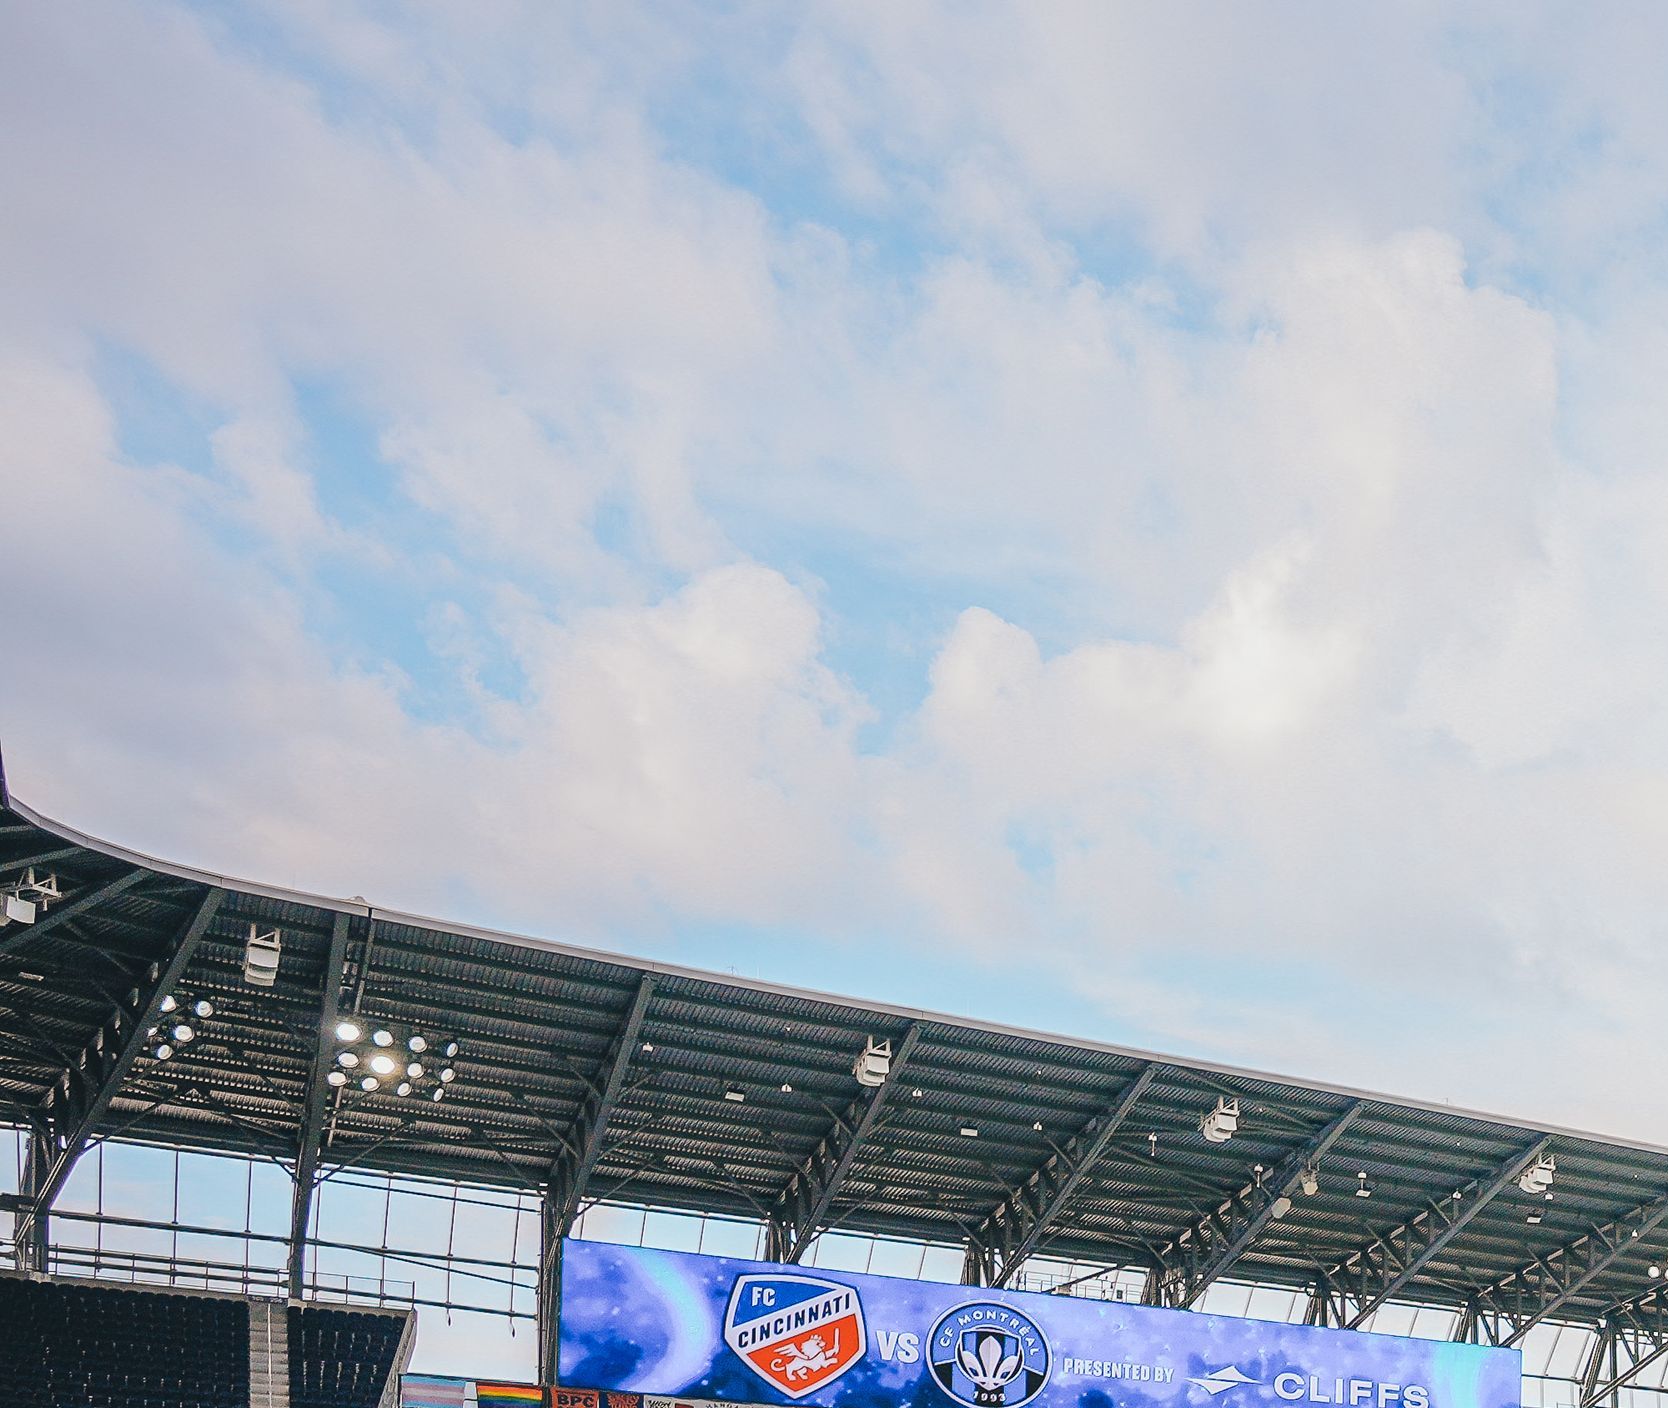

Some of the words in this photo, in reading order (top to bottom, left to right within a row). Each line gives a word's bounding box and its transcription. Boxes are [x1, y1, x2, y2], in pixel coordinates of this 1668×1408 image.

[751, 1286, 776, 1307] FC
[738, 1292, 850, 1349] CINCINNATI
[940, 1326, 955, 1347] CF
[957, 1310, 1041, 1356] MONTRÉAL
[875, 1330, 920, 1364] VS
[1063, 1358, 1151, 1383] PRESENTED
[1153, 1366, 1174, 1384] BY
[973, 1391, 1006, 1402] 1993
